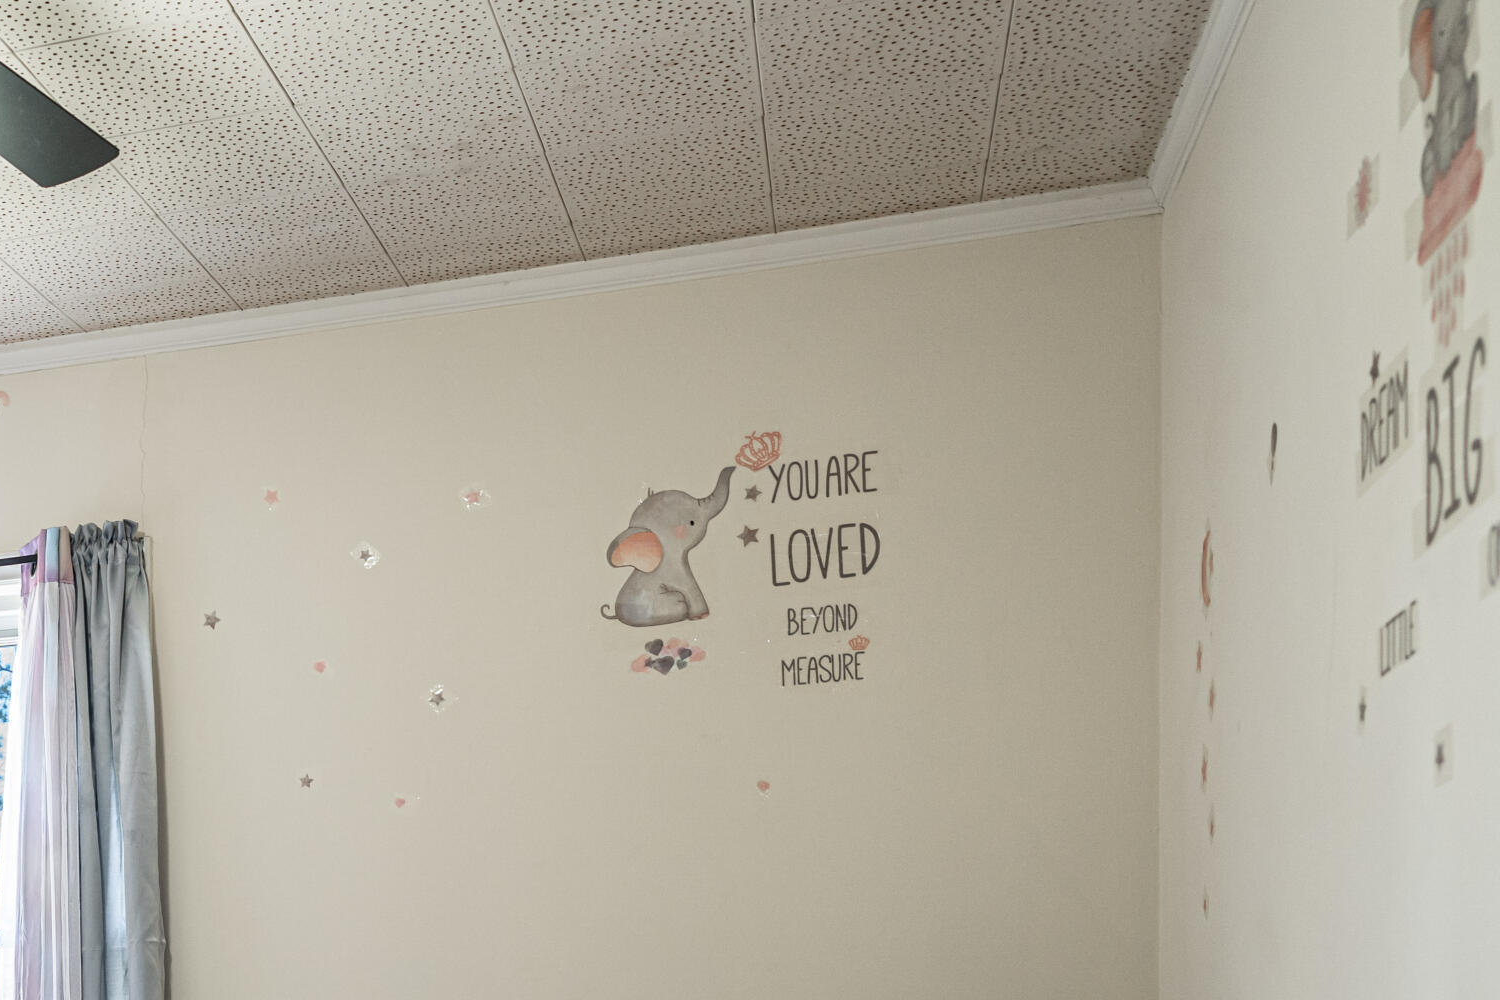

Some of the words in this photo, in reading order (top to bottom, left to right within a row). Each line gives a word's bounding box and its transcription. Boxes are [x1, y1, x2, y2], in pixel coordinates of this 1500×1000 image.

[1361, 358, 1409, 482] DREAM
[1426, 336, 1486, 547] BIG
[768, 459, 819, 503] YOU
[825, 450, 878, 498] ARE
[770, 522, 880, 587] LOVED
[787, 603, 858, 635] BEYOND
[1380, 599, 1417, 678] LITTLE
[781, 651, 866, 687] MEASURE
